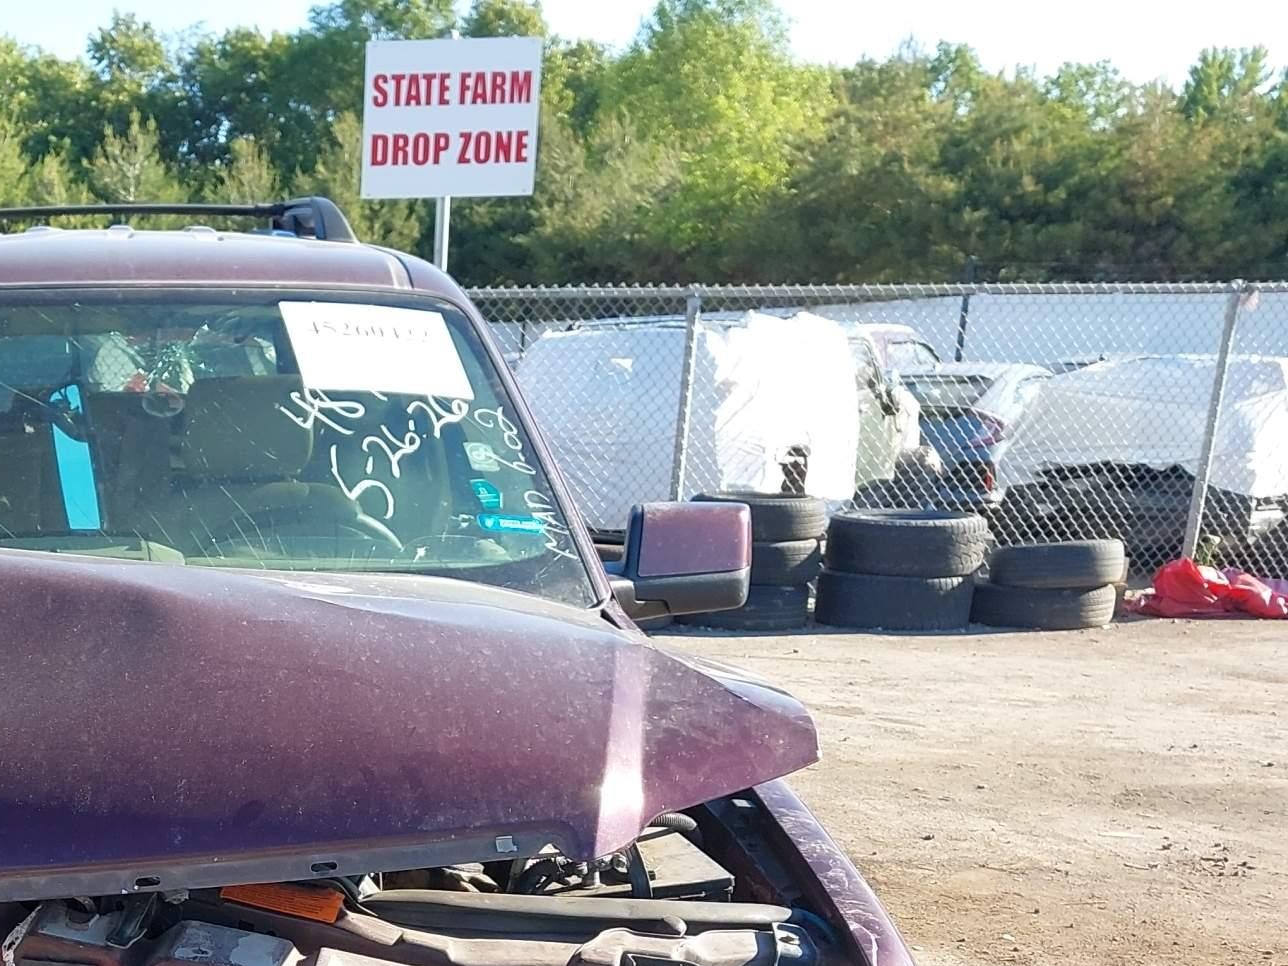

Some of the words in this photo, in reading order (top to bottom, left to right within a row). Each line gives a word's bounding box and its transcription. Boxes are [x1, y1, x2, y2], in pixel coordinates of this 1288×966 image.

[372, 73, 451, 107] STATE
[459, 71, 532, 105] FARM
[370, 133, 450, 166] DROP
[457, 131, 529, 164] ZONE
